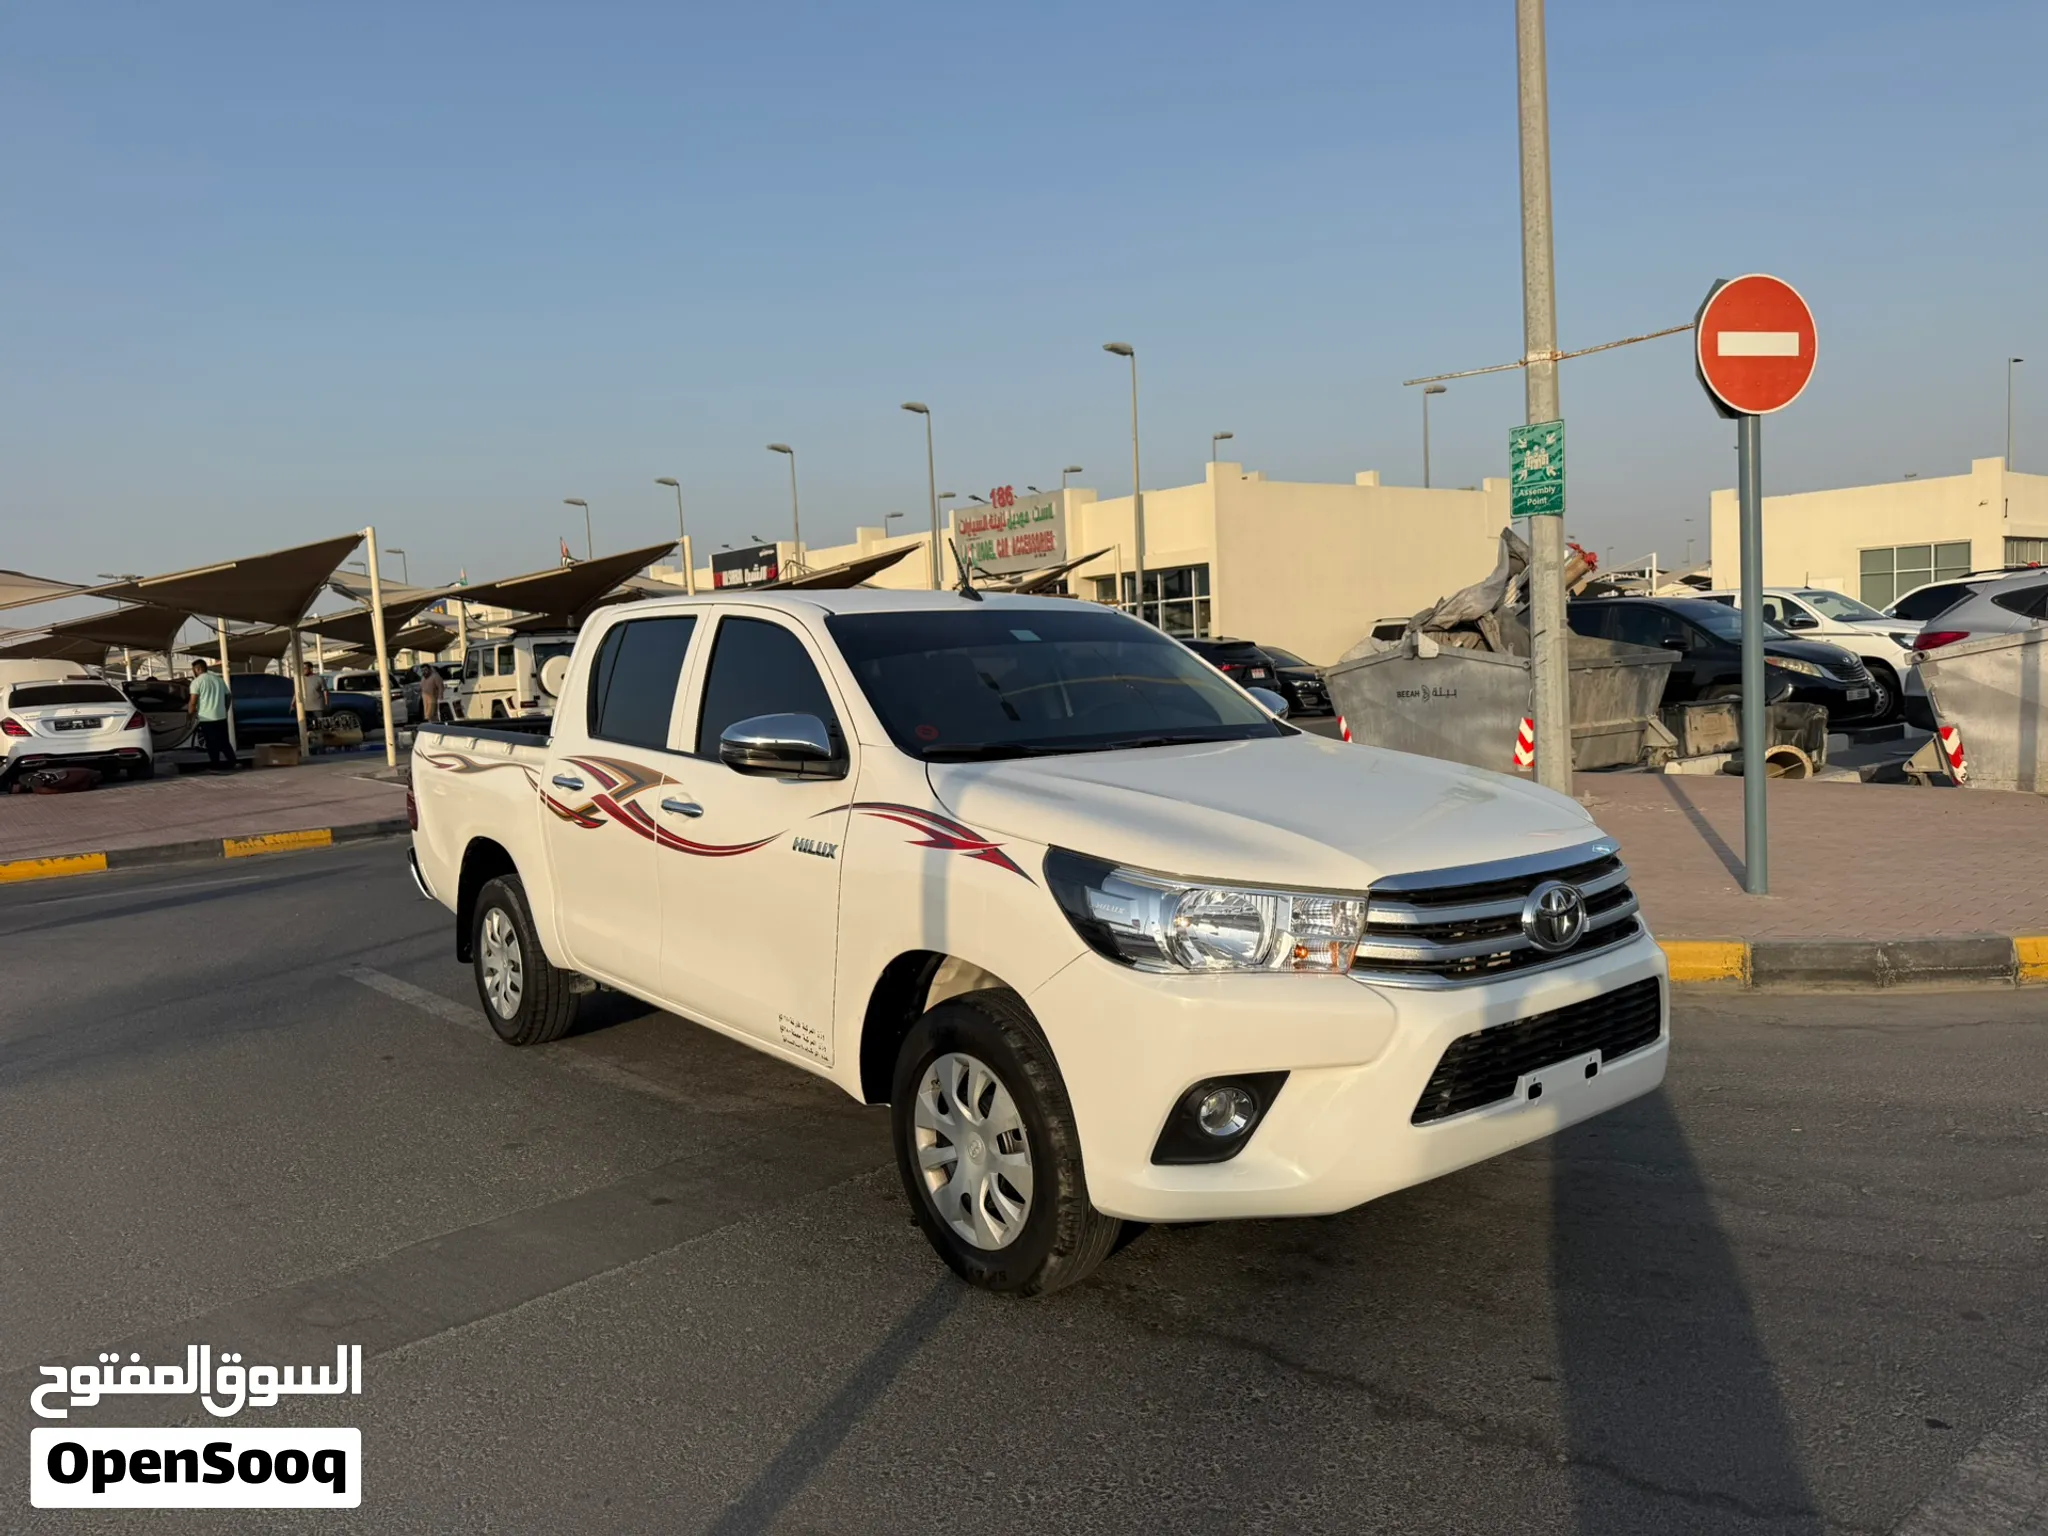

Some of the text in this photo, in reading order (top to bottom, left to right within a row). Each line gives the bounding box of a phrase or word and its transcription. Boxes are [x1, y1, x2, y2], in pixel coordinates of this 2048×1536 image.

[989, 484, 1015, 509] 186
[1519, 486, 1556, 497] Assembly
[1527, 496, 1548, 506] Point
[1396, 690, 1420, 698] BEEAH
[792, 836, 839, 859] HILUX
